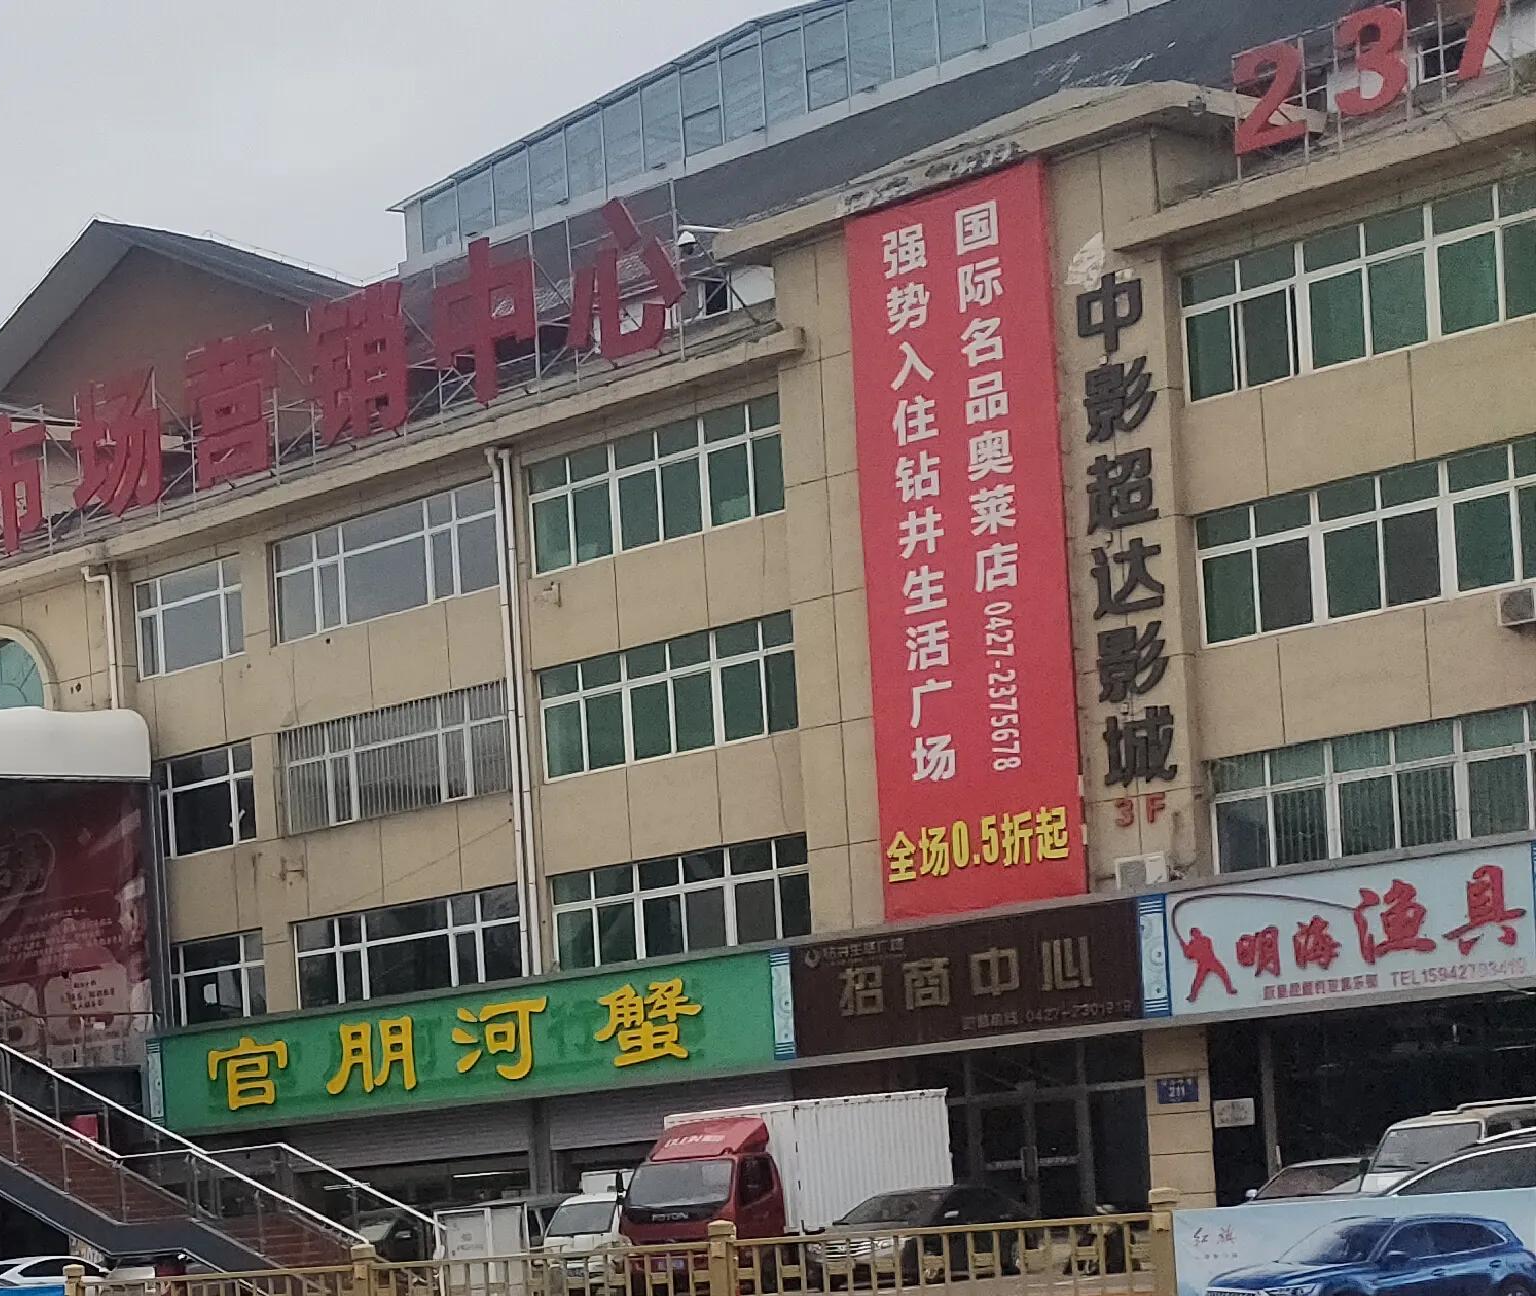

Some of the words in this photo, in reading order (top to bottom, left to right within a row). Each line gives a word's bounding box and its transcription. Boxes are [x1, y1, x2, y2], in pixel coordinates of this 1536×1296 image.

[955, 200, 1019, 592] 国际名品奥莱店
[882, 223, 957, 783] 强势入住钻井生活广场
[1076, 268, 1179, 790] 中影超达影城
[984, 602, 1021, 773] 0427-2375678
[887, 804, 1071, 884] 全场0.5折起
[1115, 794, 1167, 829] 3F
[839, 935, 1094, 1017] 招商中心
[1236, 864, 1527, 978] 明海渔具
[207, 977, 704, 1111] 官朋河蟹
